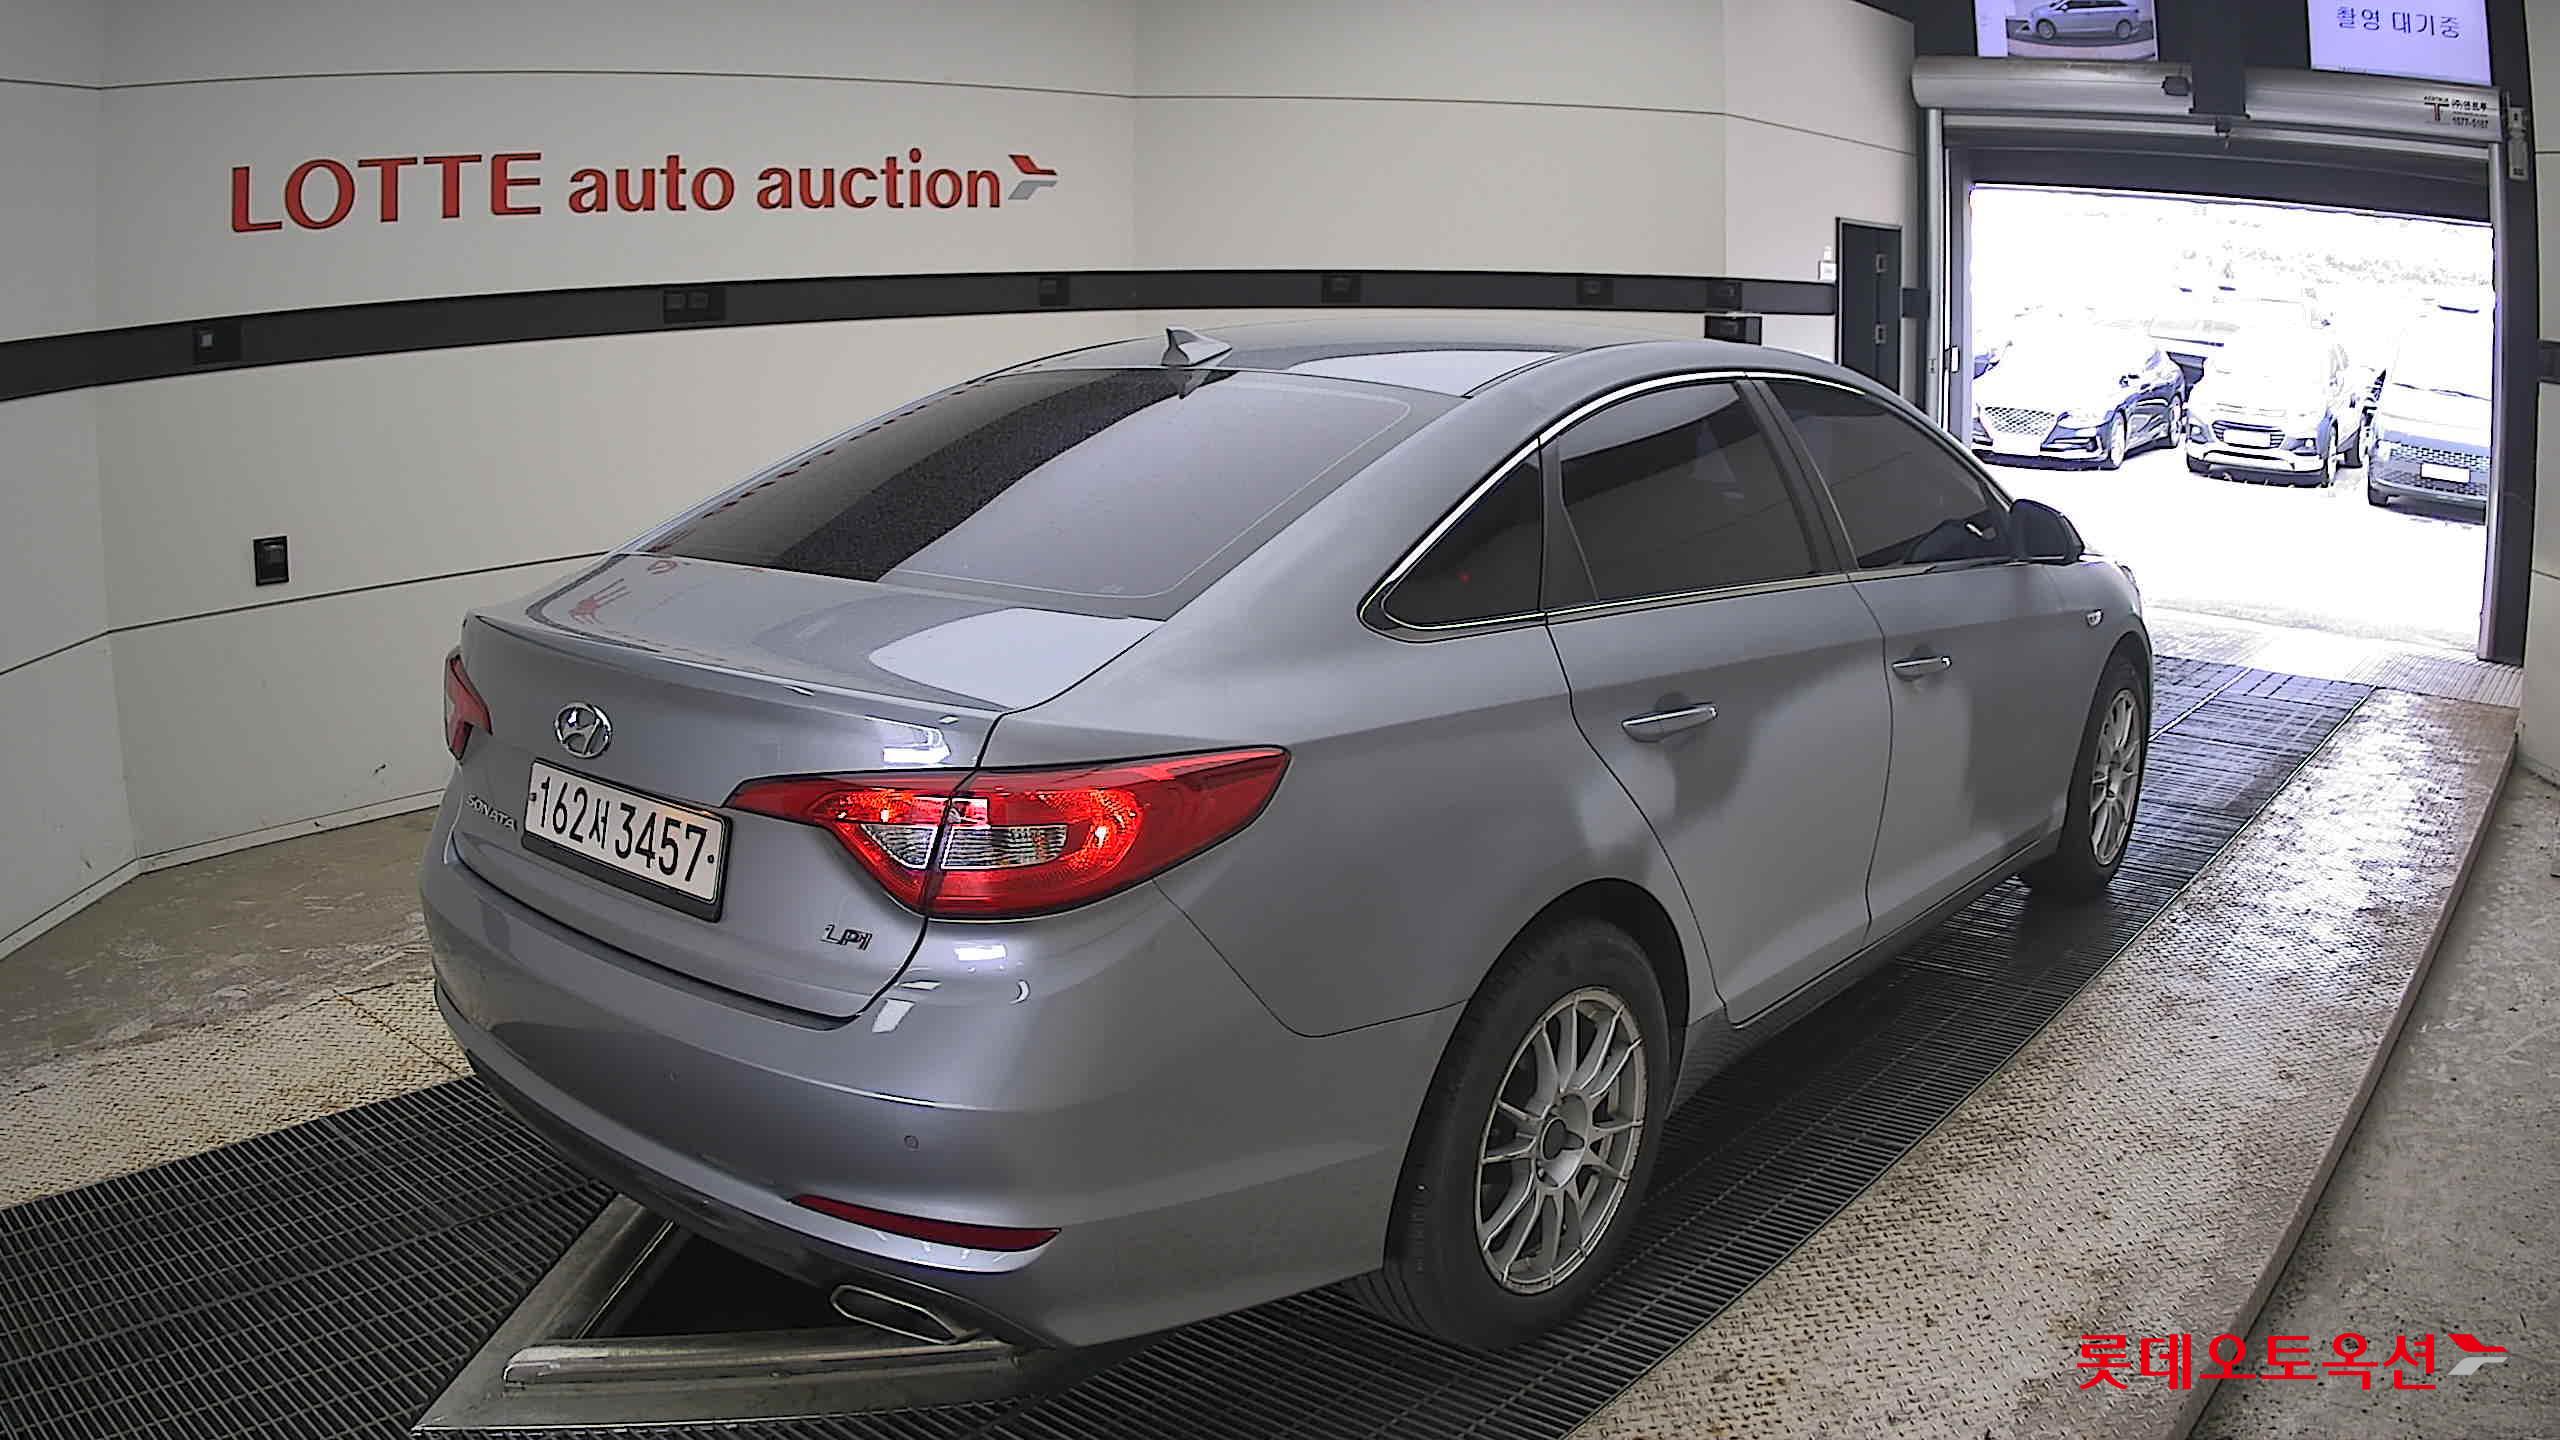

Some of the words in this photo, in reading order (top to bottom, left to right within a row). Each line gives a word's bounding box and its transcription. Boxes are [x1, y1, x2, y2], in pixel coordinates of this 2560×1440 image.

[2337, 5, 2380, 31] 촬영
[2392, 11, 2460, 39] 대기중
[231, 152, 542, 233] LOTTE
[568, 154, 736, 214] auto
[756, 147, 1001, 210] auction
[466, 794, 518, 832] SONATA
[540, 776, 610, 850] 162서
[614, 803, 708, 882] 3457
